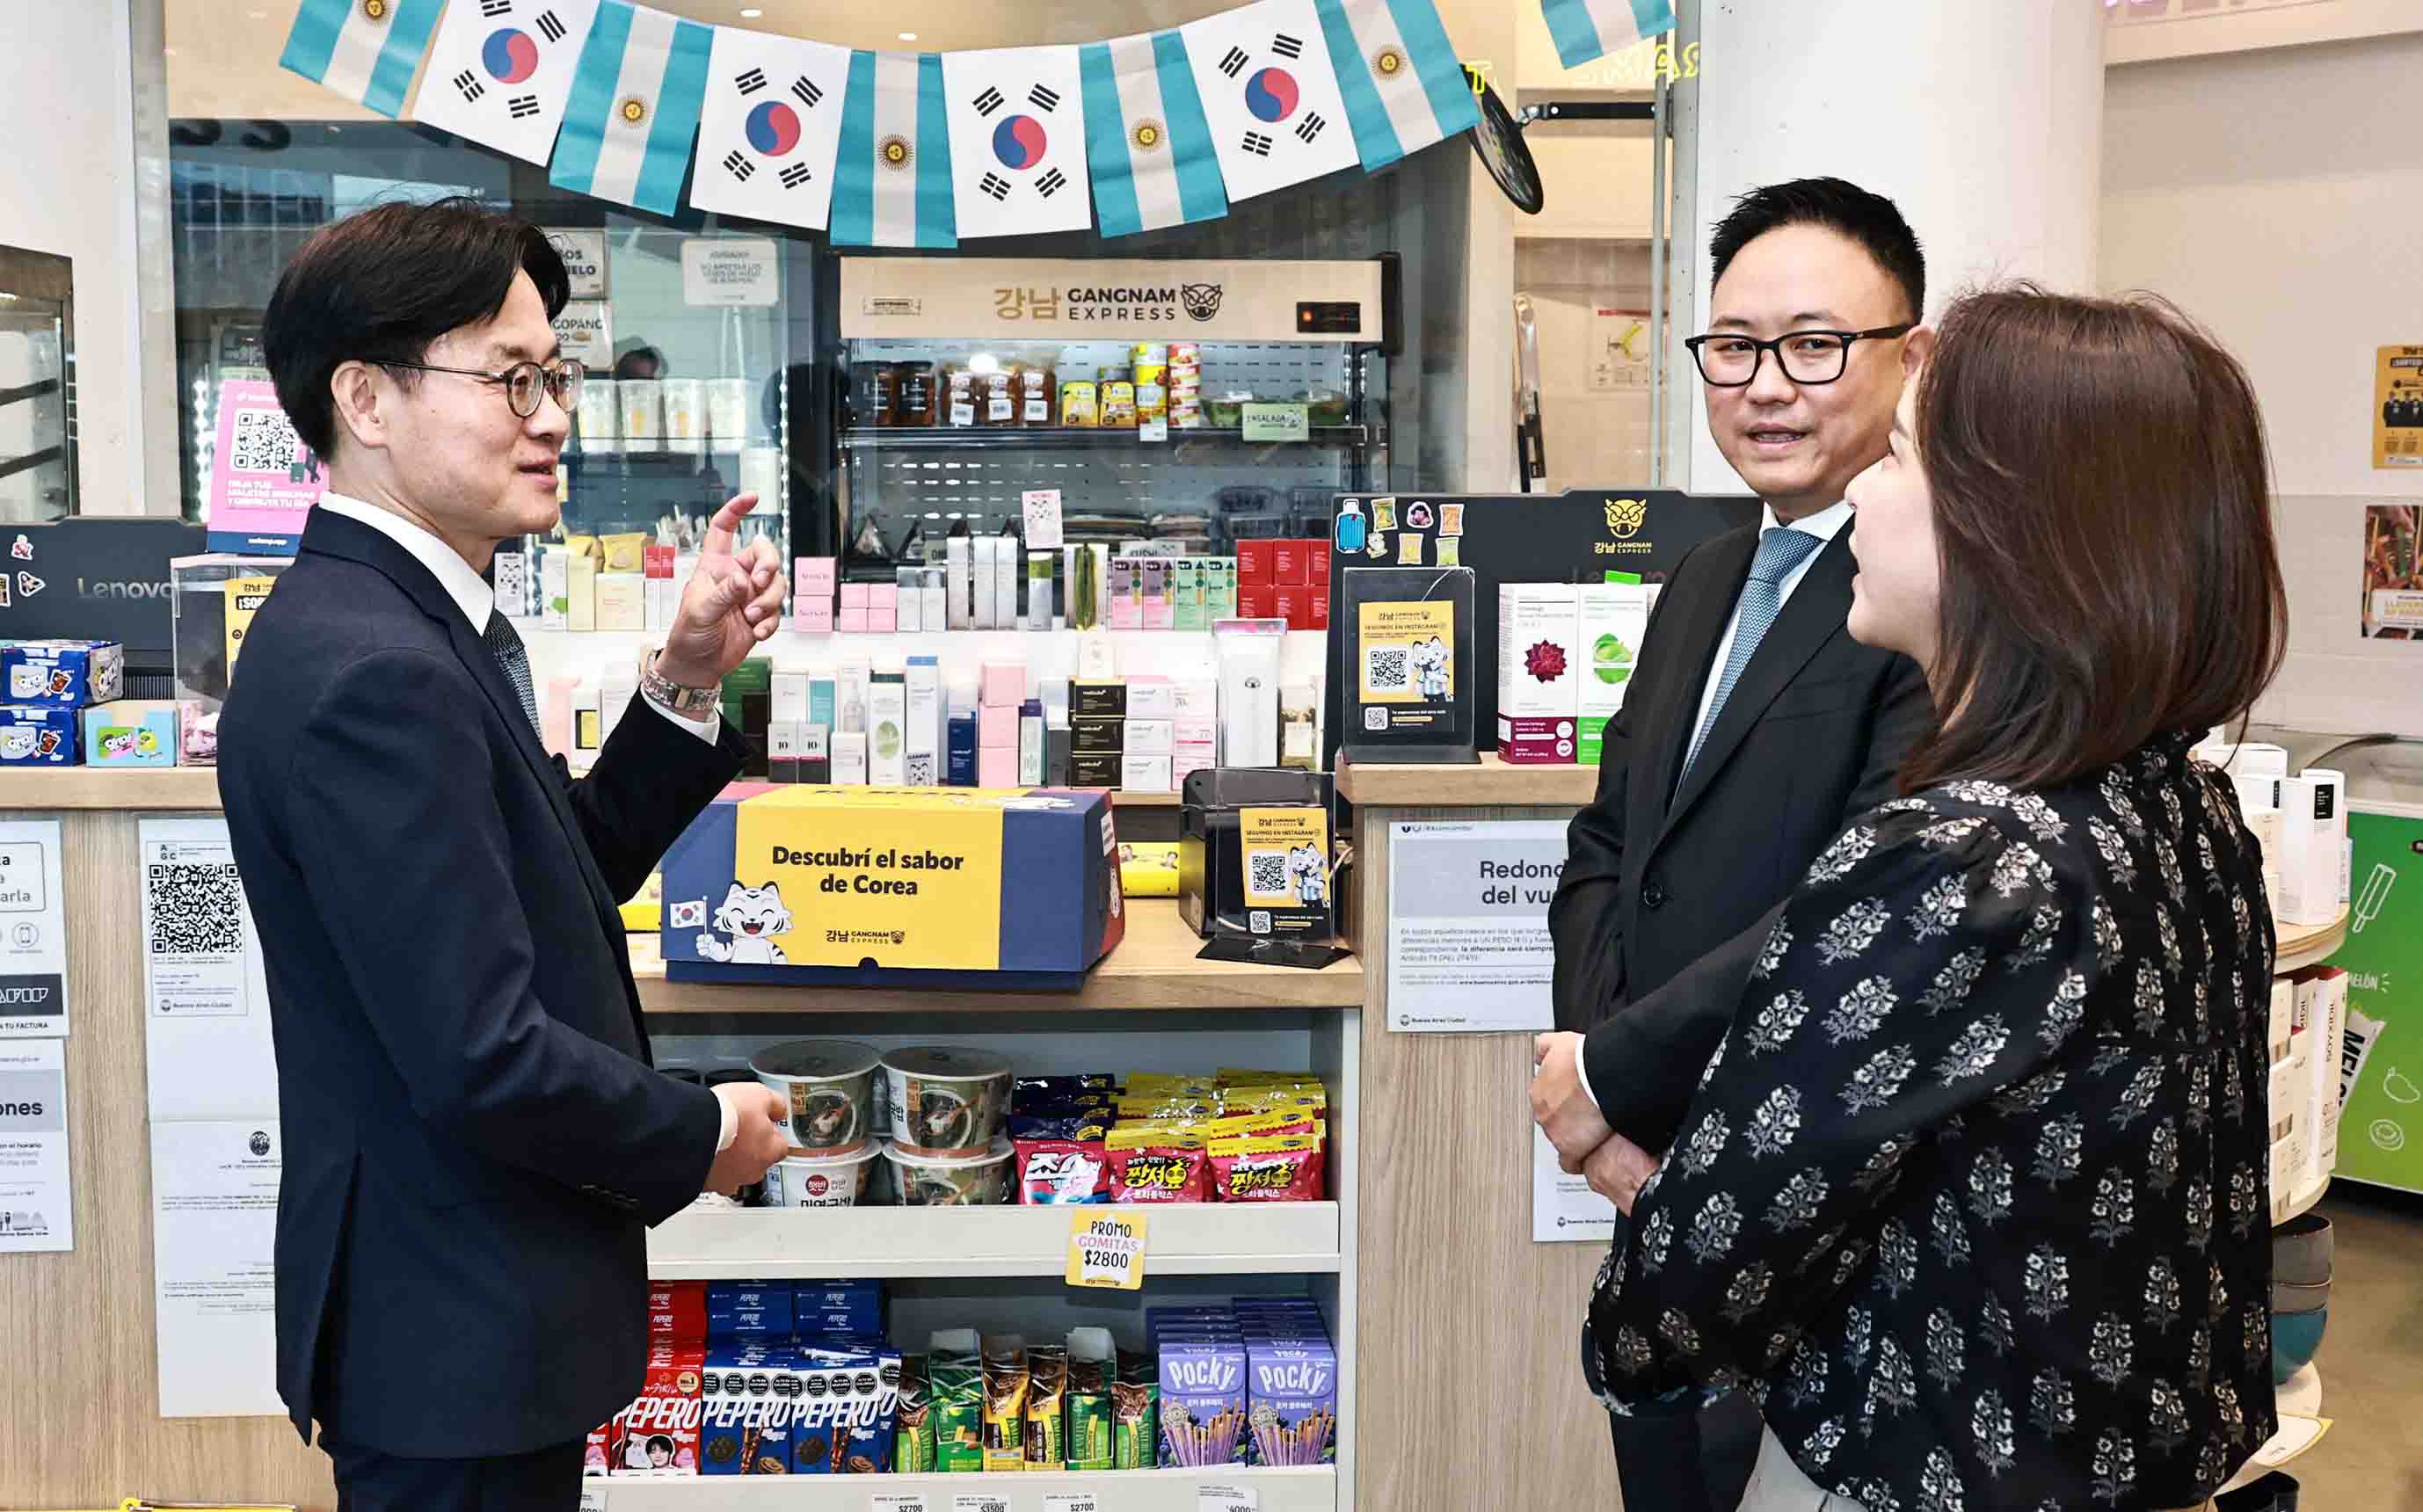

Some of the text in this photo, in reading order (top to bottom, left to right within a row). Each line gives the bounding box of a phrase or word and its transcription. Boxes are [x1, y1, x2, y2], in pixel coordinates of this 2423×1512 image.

[994, 287, 1062, 321] 강남
[1066, 287, 1176, 304] GANGNAM
[1068, 307, 1175, 321] EXPRESS
[76, 577, 174, 599] Lenovo
[772, 846, 964, 871] Descubrí el sabor
[819, 874, 919, 895] de Corea
[1481, 884, 1553, 905] del vu
[826, 929, 849, 943] 강남
[1090, 1220, 1131, 1239] PROMO
[1078, 1236, 1139, 1253] GOMITAS
[1084, 1248, 1129, 1268] $2800
[702, 1398, 792, 1428] PEPERO
[790, 1396, 880, 1429] PEPERO
[1069, 1502, 1095, 1512] $2700
